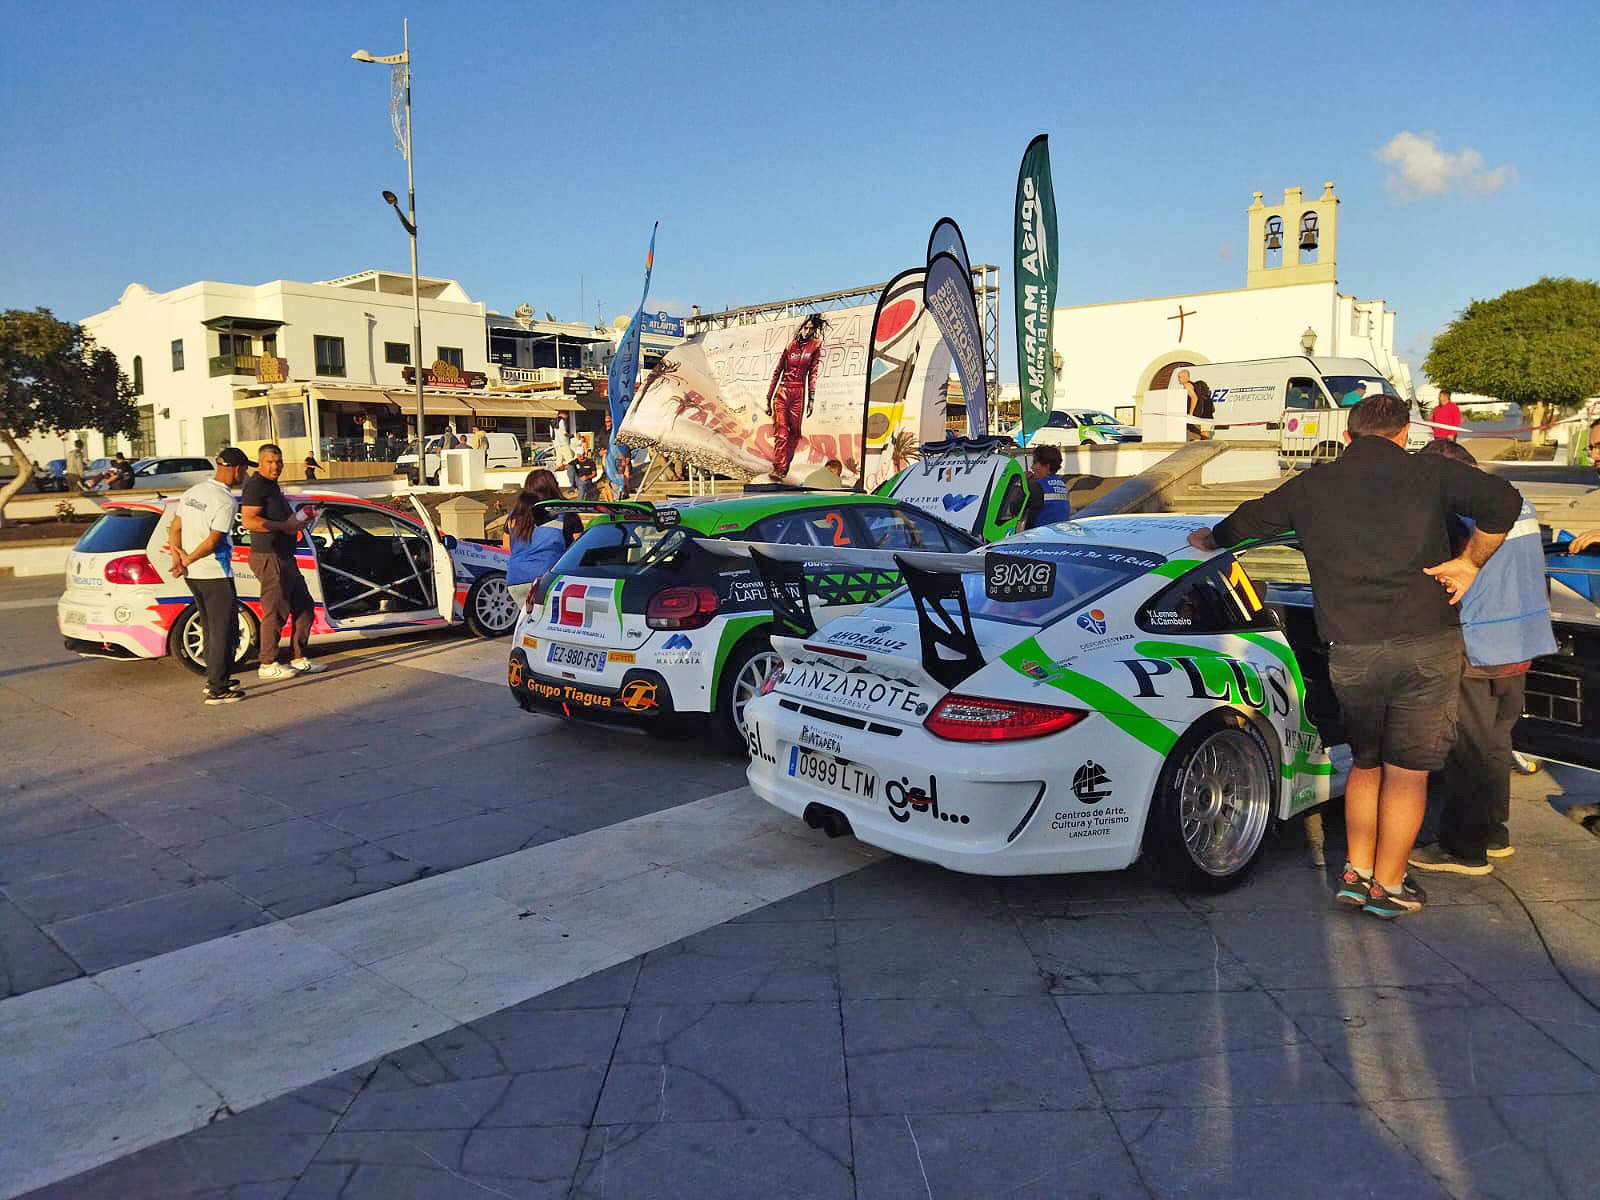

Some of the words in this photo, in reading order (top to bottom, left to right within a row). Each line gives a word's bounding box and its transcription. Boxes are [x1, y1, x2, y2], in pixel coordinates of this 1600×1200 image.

[826, 512, 850, 547] 2
[991, 563, 1051, 586] 3MG
[831, 631, 908, 650] AHORALUZ
[553, 645, 599, 670] EZ-980-FS
[527, 678, 561, 697] Grupo
[562, 686, 611, 707] Tiagua
[784, 667, 920, 712] LANZAROTE
[1114, 656, 1289, 717] PLUS
[799, 753, 837, 786] 0999
[842, 766, 877, 799] LTM
[1051, 820, 1086, 830] Cultura
[1087, 820, 1093, 828] y
[1094, 816, 1129, 826] Turismo
[1055, 811, 1091, 820] Centros
[1093, 808, 1103, 817] de
[1105, 807, 1126, 816] Arte,
[1069, 828, 1112, 839] LANZAROTE
